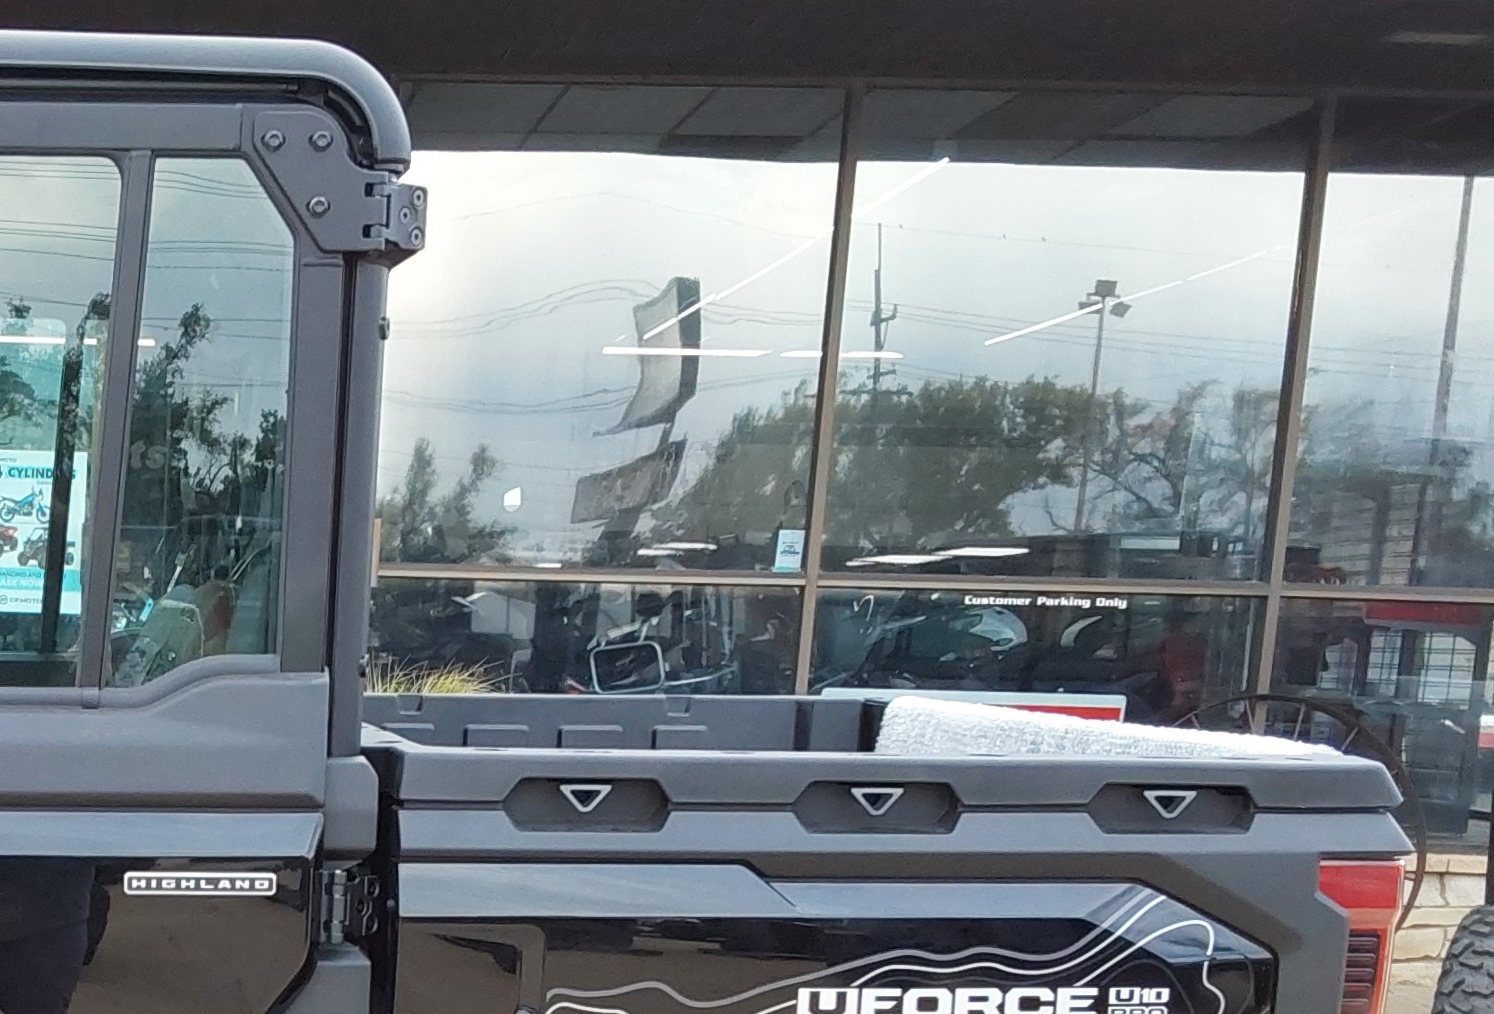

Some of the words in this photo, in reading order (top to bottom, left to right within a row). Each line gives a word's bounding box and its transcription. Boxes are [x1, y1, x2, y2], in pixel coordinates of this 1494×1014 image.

[964, 595, 1032, 606] Customer
[1037, 596, 1091, 609] Parking
[1096, 597, 1128, 609] Only
[131, 878, 270, 890] HIGHLAND
[1108, 987, 1170, 1004] U10
